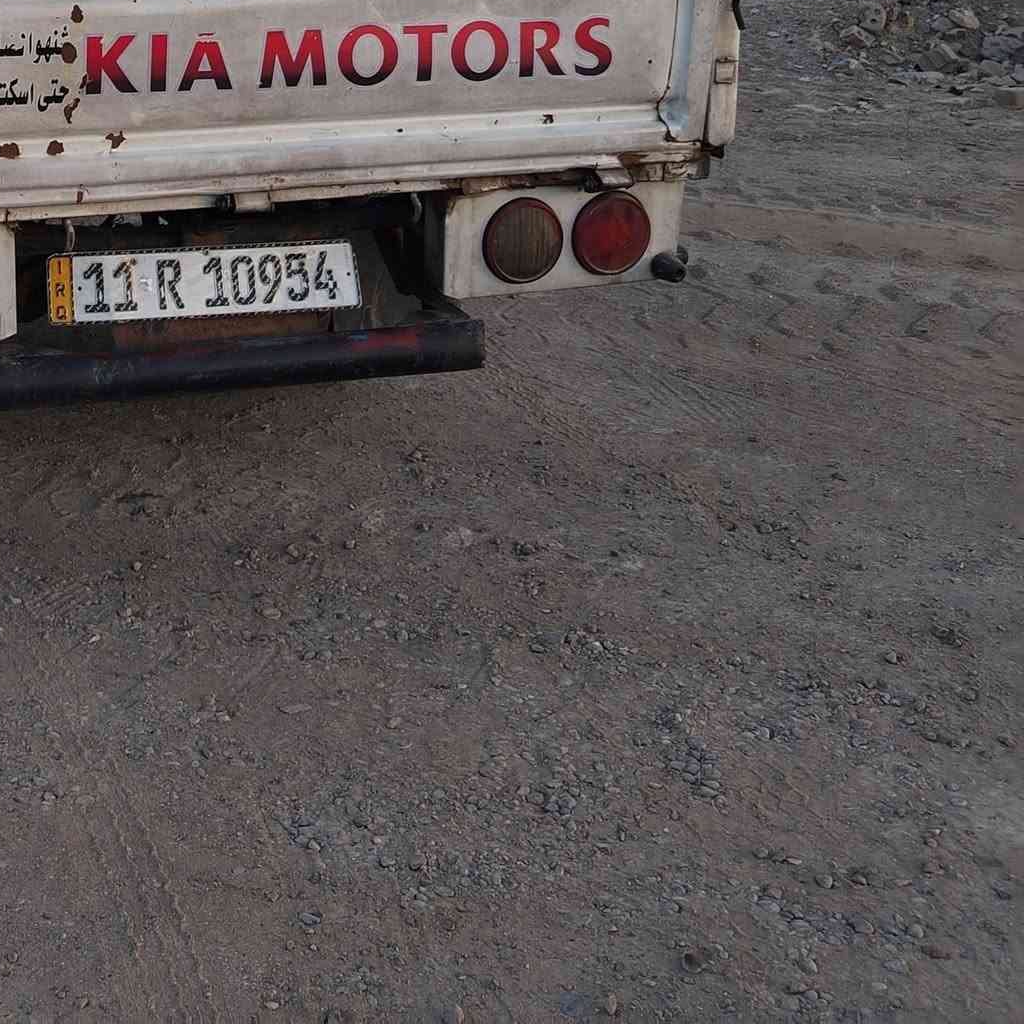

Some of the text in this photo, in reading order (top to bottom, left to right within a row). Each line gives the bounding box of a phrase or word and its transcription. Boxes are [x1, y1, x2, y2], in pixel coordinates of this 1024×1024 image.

[259, 17, 612, 89] MOTORS
[38, 79, 69, 112] حتى
[83, 251, 338, 313] 11 R 10954
